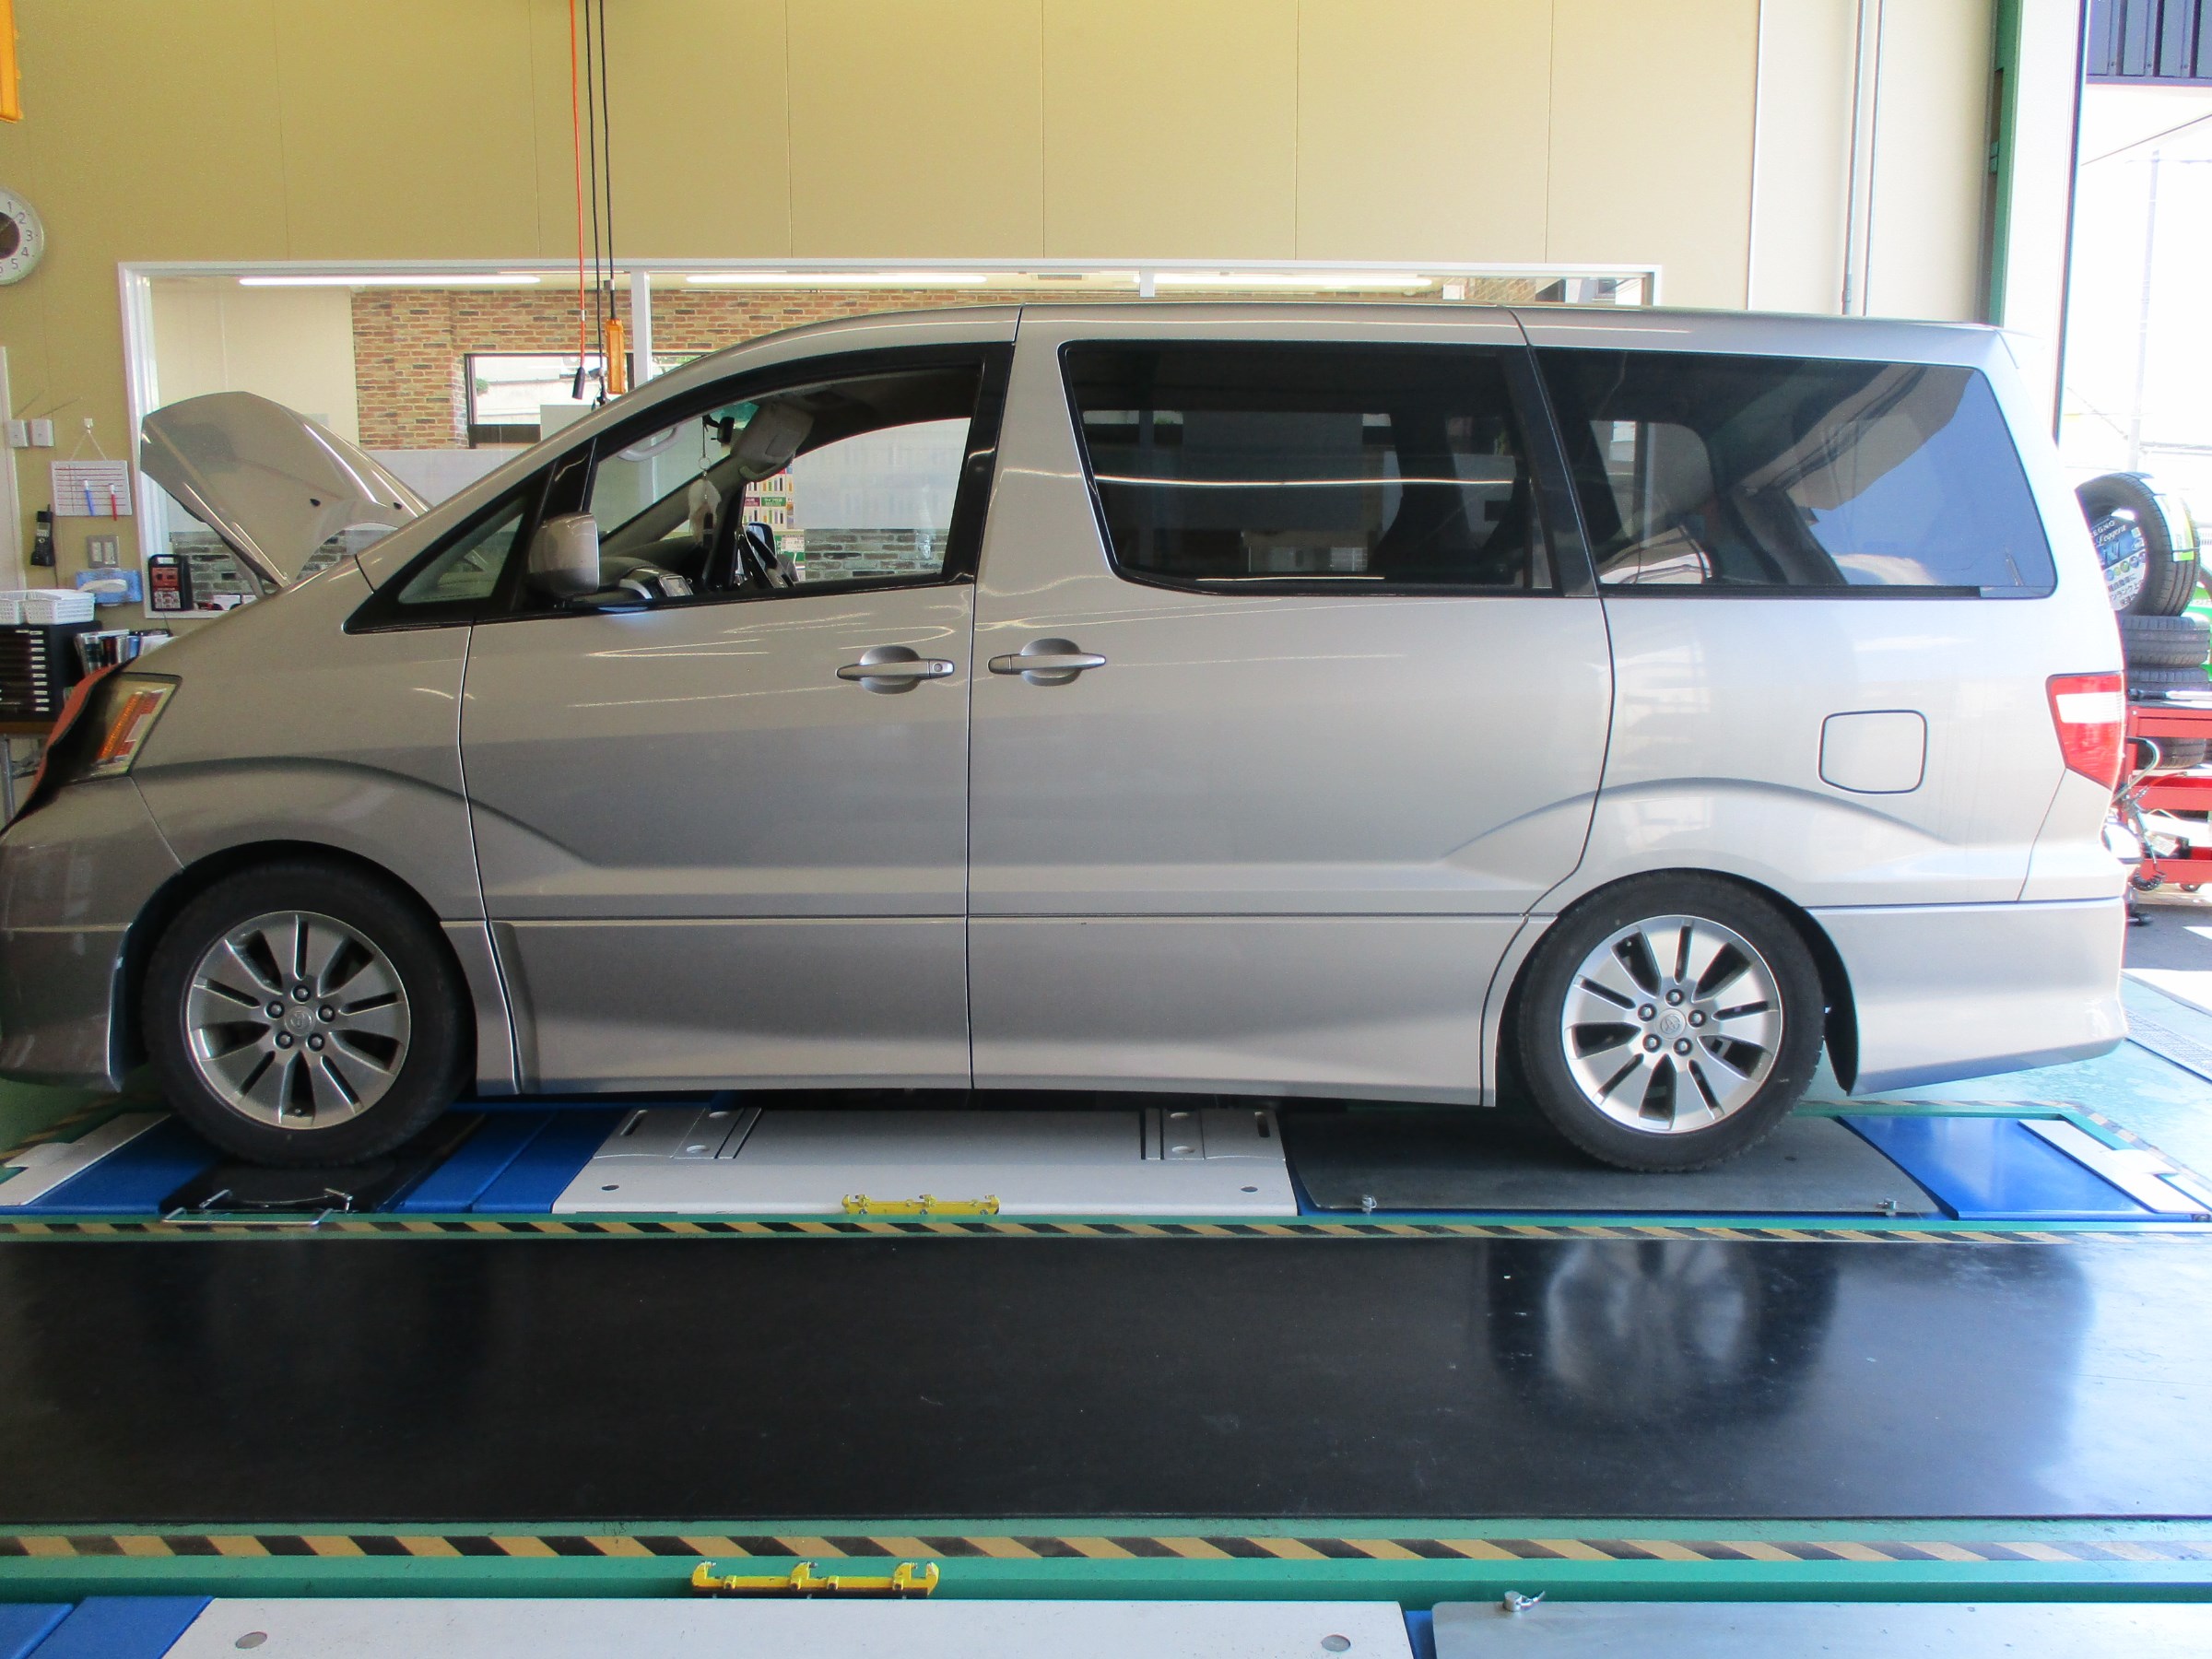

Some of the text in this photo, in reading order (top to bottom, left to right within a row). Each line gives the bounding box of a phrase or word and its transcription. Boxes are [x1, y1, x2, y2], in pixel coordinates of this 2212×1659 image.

[7, 201, 12, 212] 1
[18, 212, 27, 224] 2
[26, 229, 33, 241] 3
[21, 246, 29, 257] 4
[11, 258, 18, 269] 5
[2091, 520, 2115, 536] EGNO
